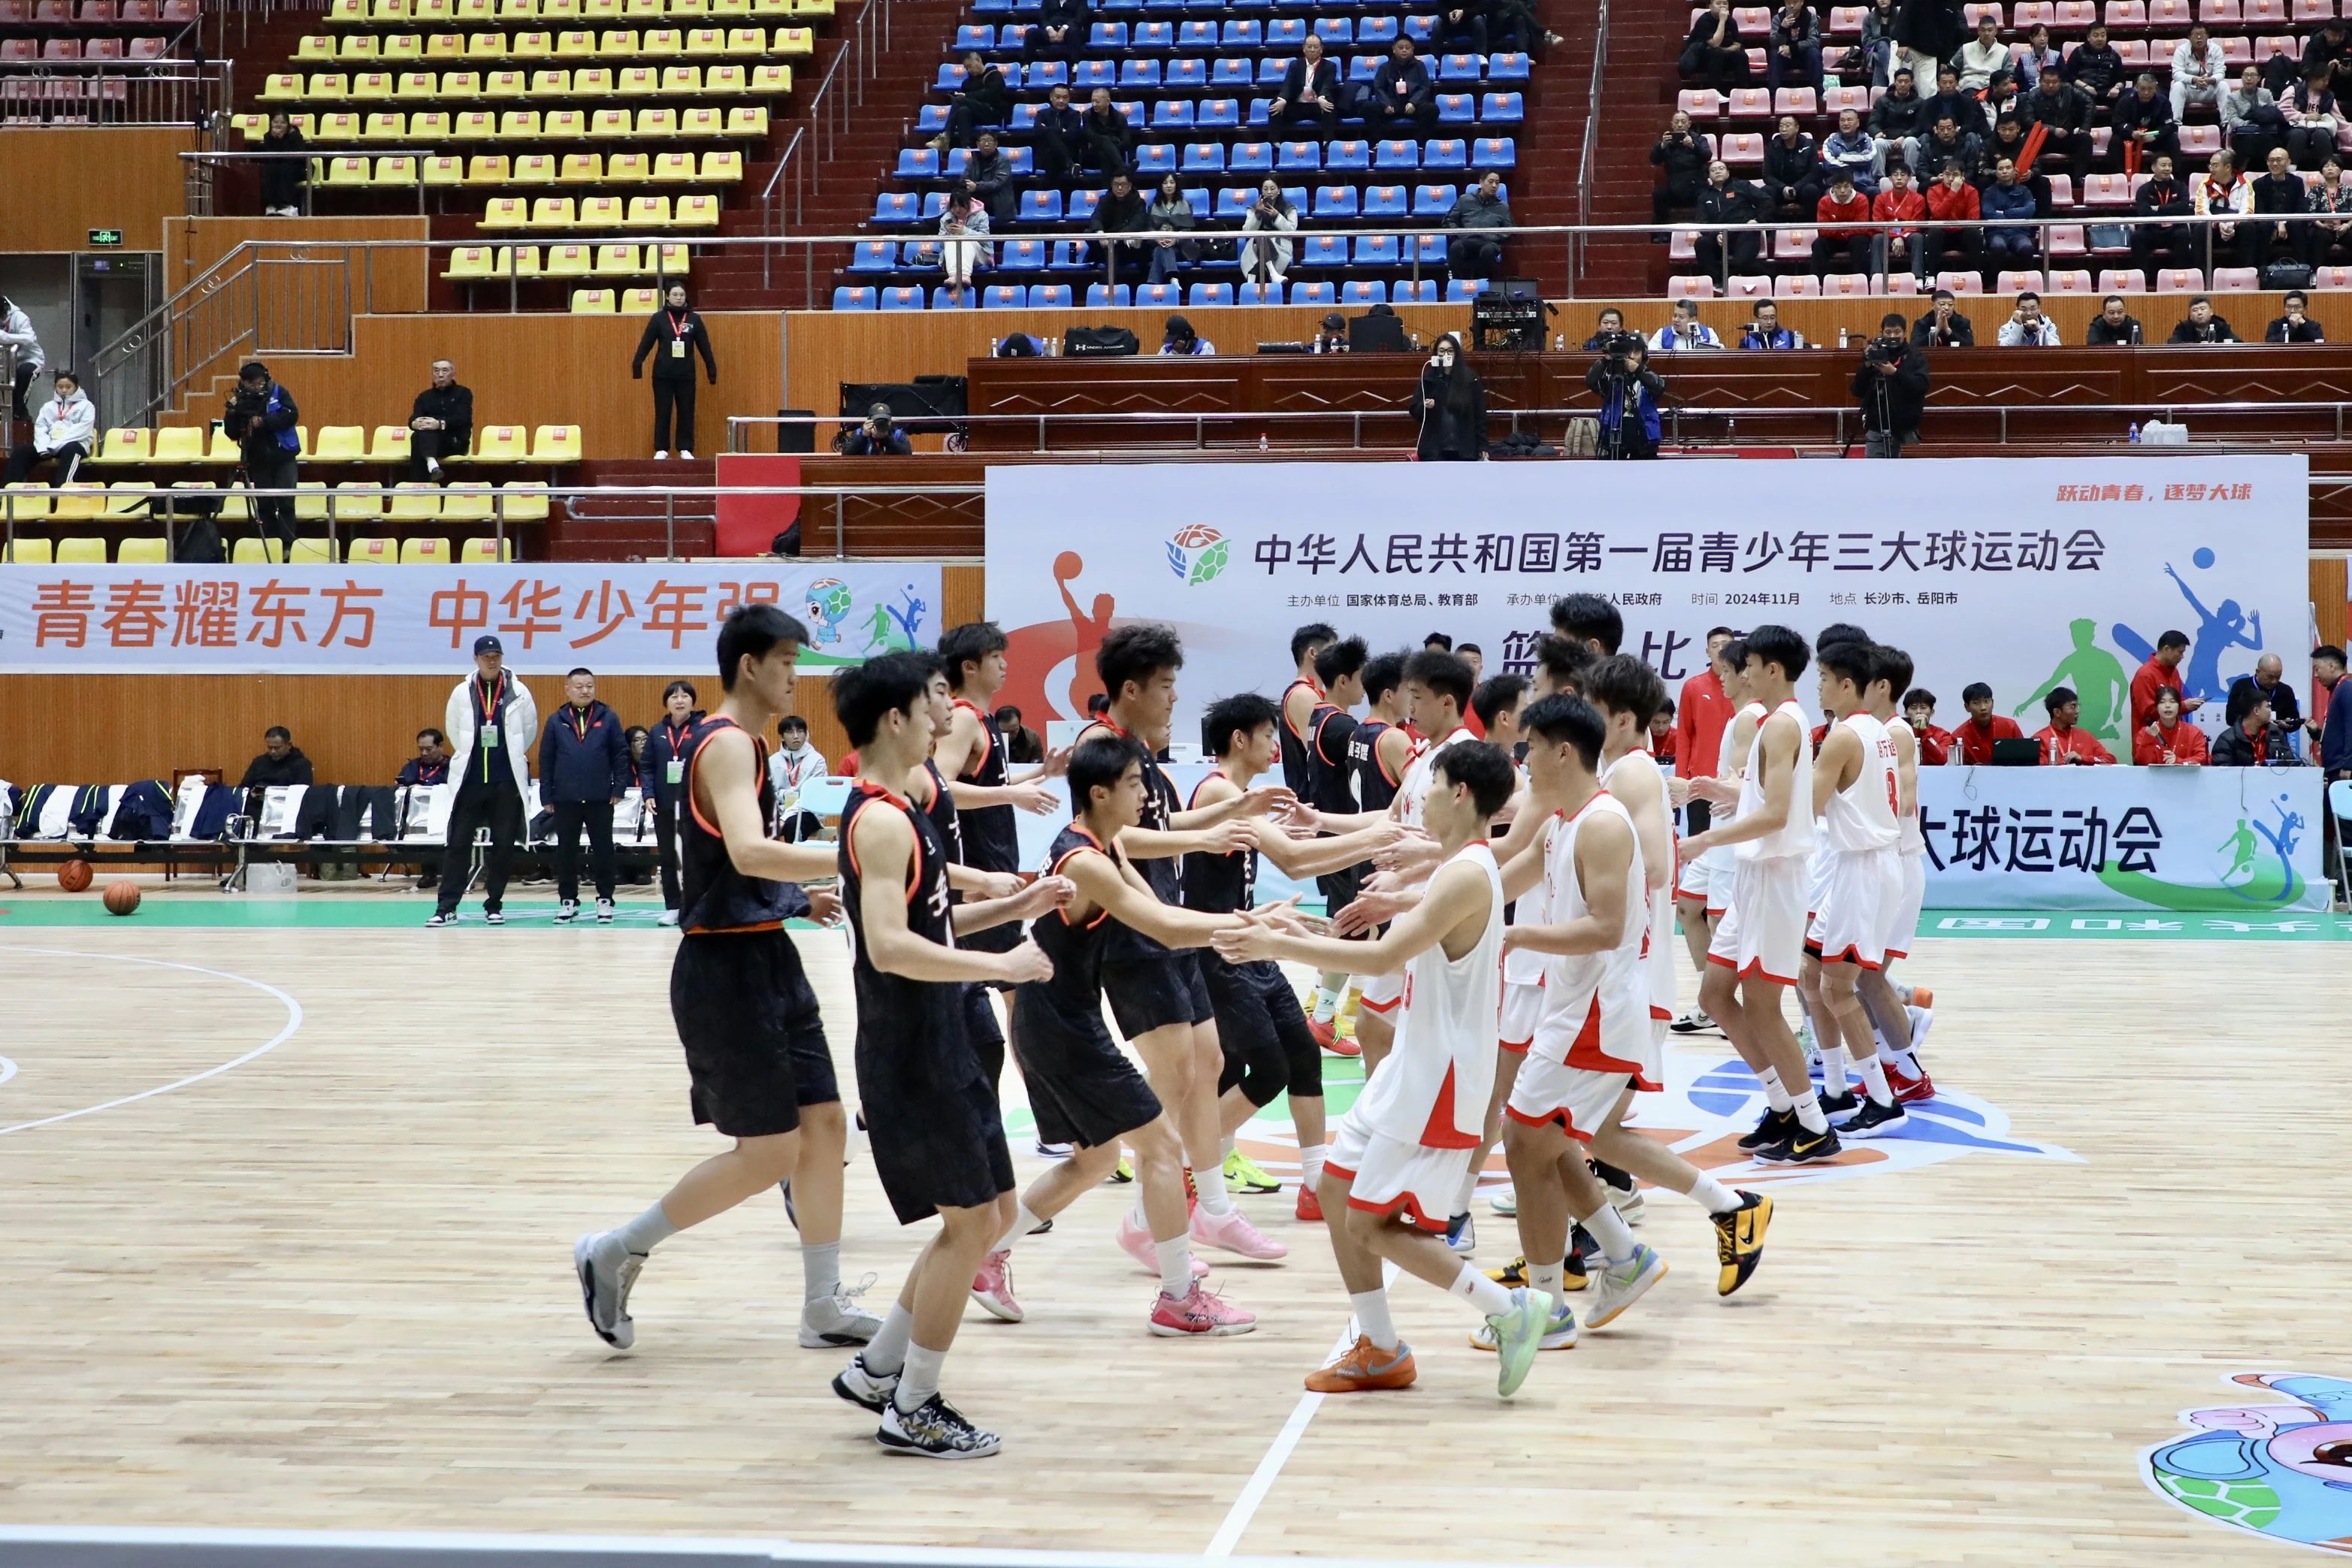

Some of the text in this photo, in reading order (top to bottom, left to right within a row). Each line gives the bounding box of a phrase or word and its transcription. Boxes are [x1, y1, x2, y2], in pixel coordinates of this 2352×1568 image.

[2057, 484, 2252, 502] 跃动青春，逐梦大球
[1255, 529, 2106, 576] 中华人民共和国第一届青少年三大球运动会
[32, 579, 384, 648] 青春耀东方
[1287, 594, 1341, 607] 主办单位
[1347, 593, 1478, 607] 国家体育总局、教育部
[1507, 594, 1559, 606] 承办单位
[1691, 593, 1718, 606] 时间
[1725, 592, 1800, 606] 2024年11月
[1829, 592, 1857, 606] 地点
[1864, 591, 1958, 606] 长沙市、岳阳市
[1920, 805, 2163, 875] 大球运动会
[1918, 917, 2352, 933] 共和国
